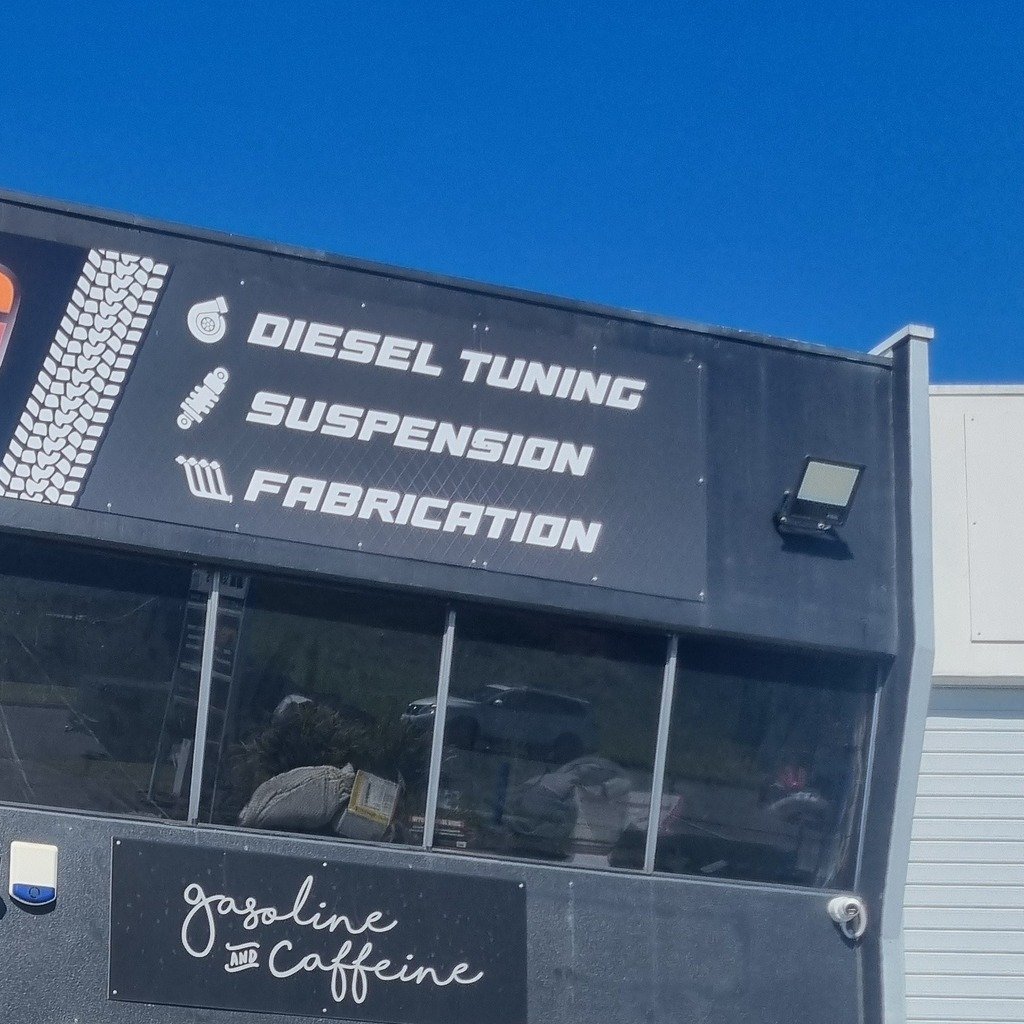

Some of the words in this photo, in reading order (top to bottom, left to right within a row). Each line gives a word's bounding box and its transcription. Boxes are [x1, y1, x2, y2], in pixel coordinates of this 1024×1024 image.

[247, 313, 442, 377] DIESEL
[459, 350, 647, 410] TUNING
[246, 392, 594, 476] SUSPENSION
[244, 470, 602, 553] FABRICATION
[181, 875, 398, 957] gasoline
[227, 945, 259, 970] AND
[269, 940, 484, 1004] Caffeine
